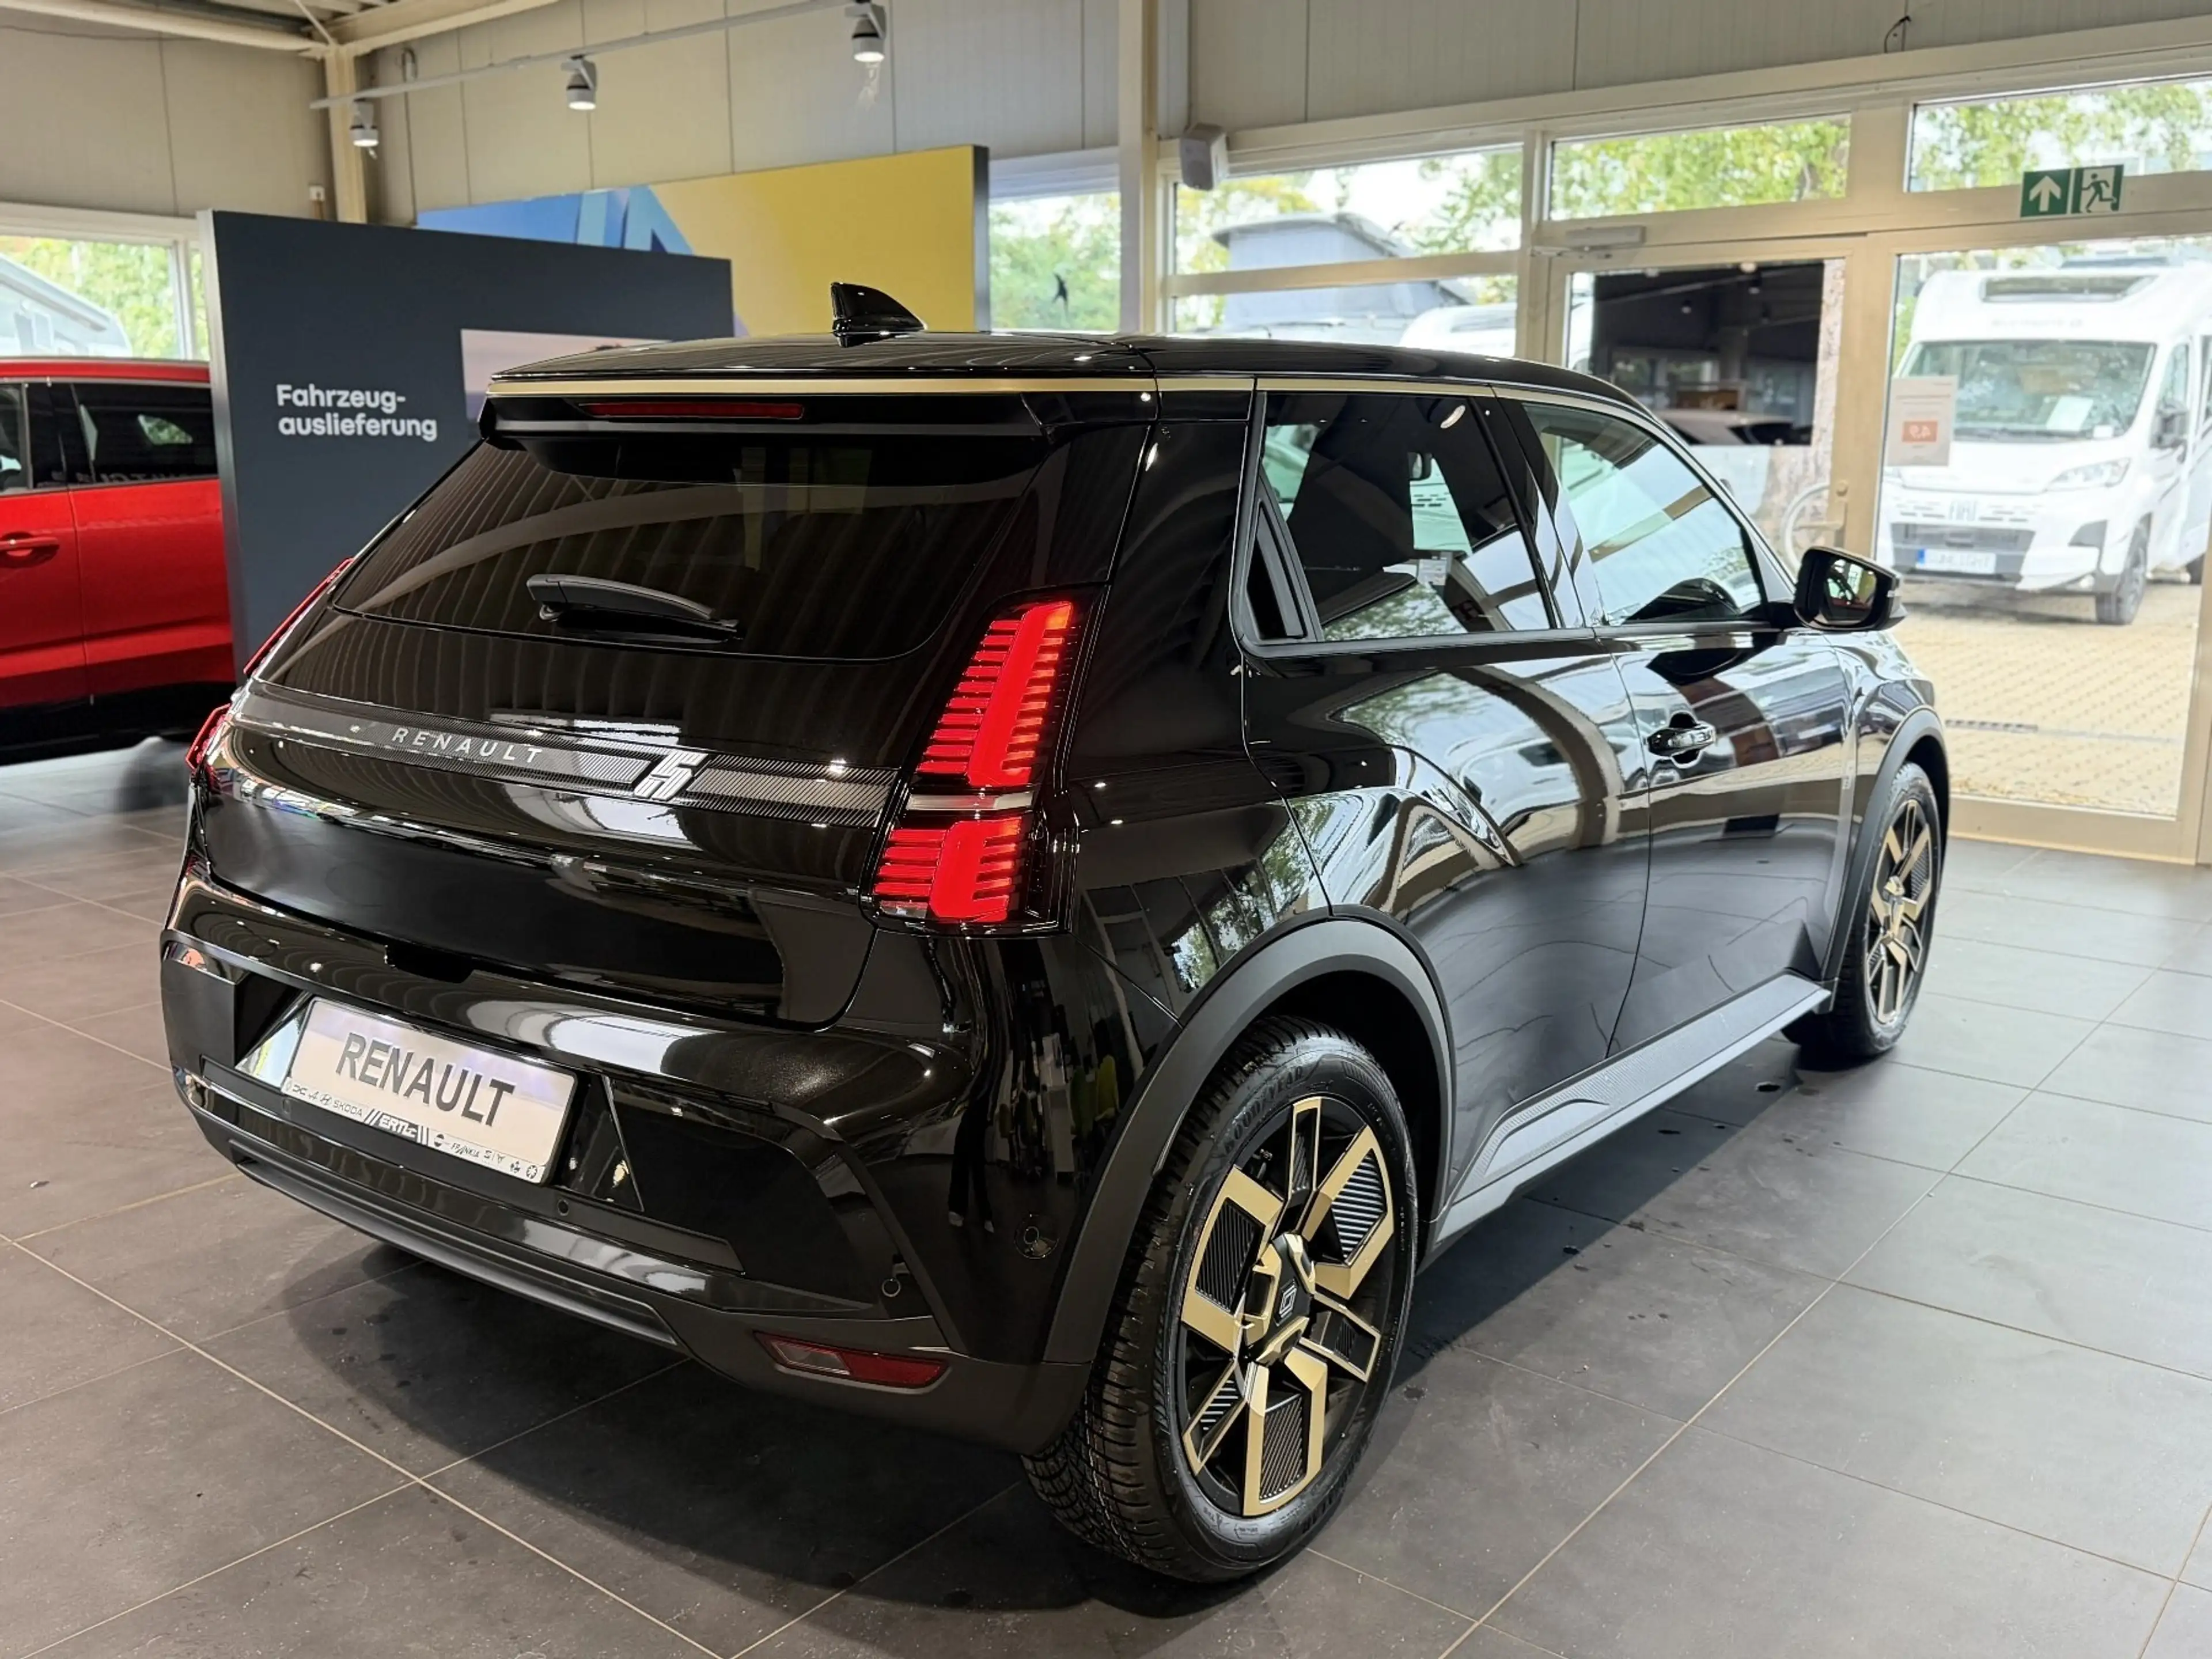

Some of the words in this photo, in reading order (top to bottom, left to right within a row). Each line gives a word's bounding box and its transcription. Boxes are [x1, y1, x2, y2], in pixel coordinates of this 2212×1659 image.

[276, 384, 405, 414] Fahrzeug-
[278, 411, 438, 442] auslieferung
[392, 727, 543, 764] RENAULT
[335, 1031, 516, 1127] RENAULT
